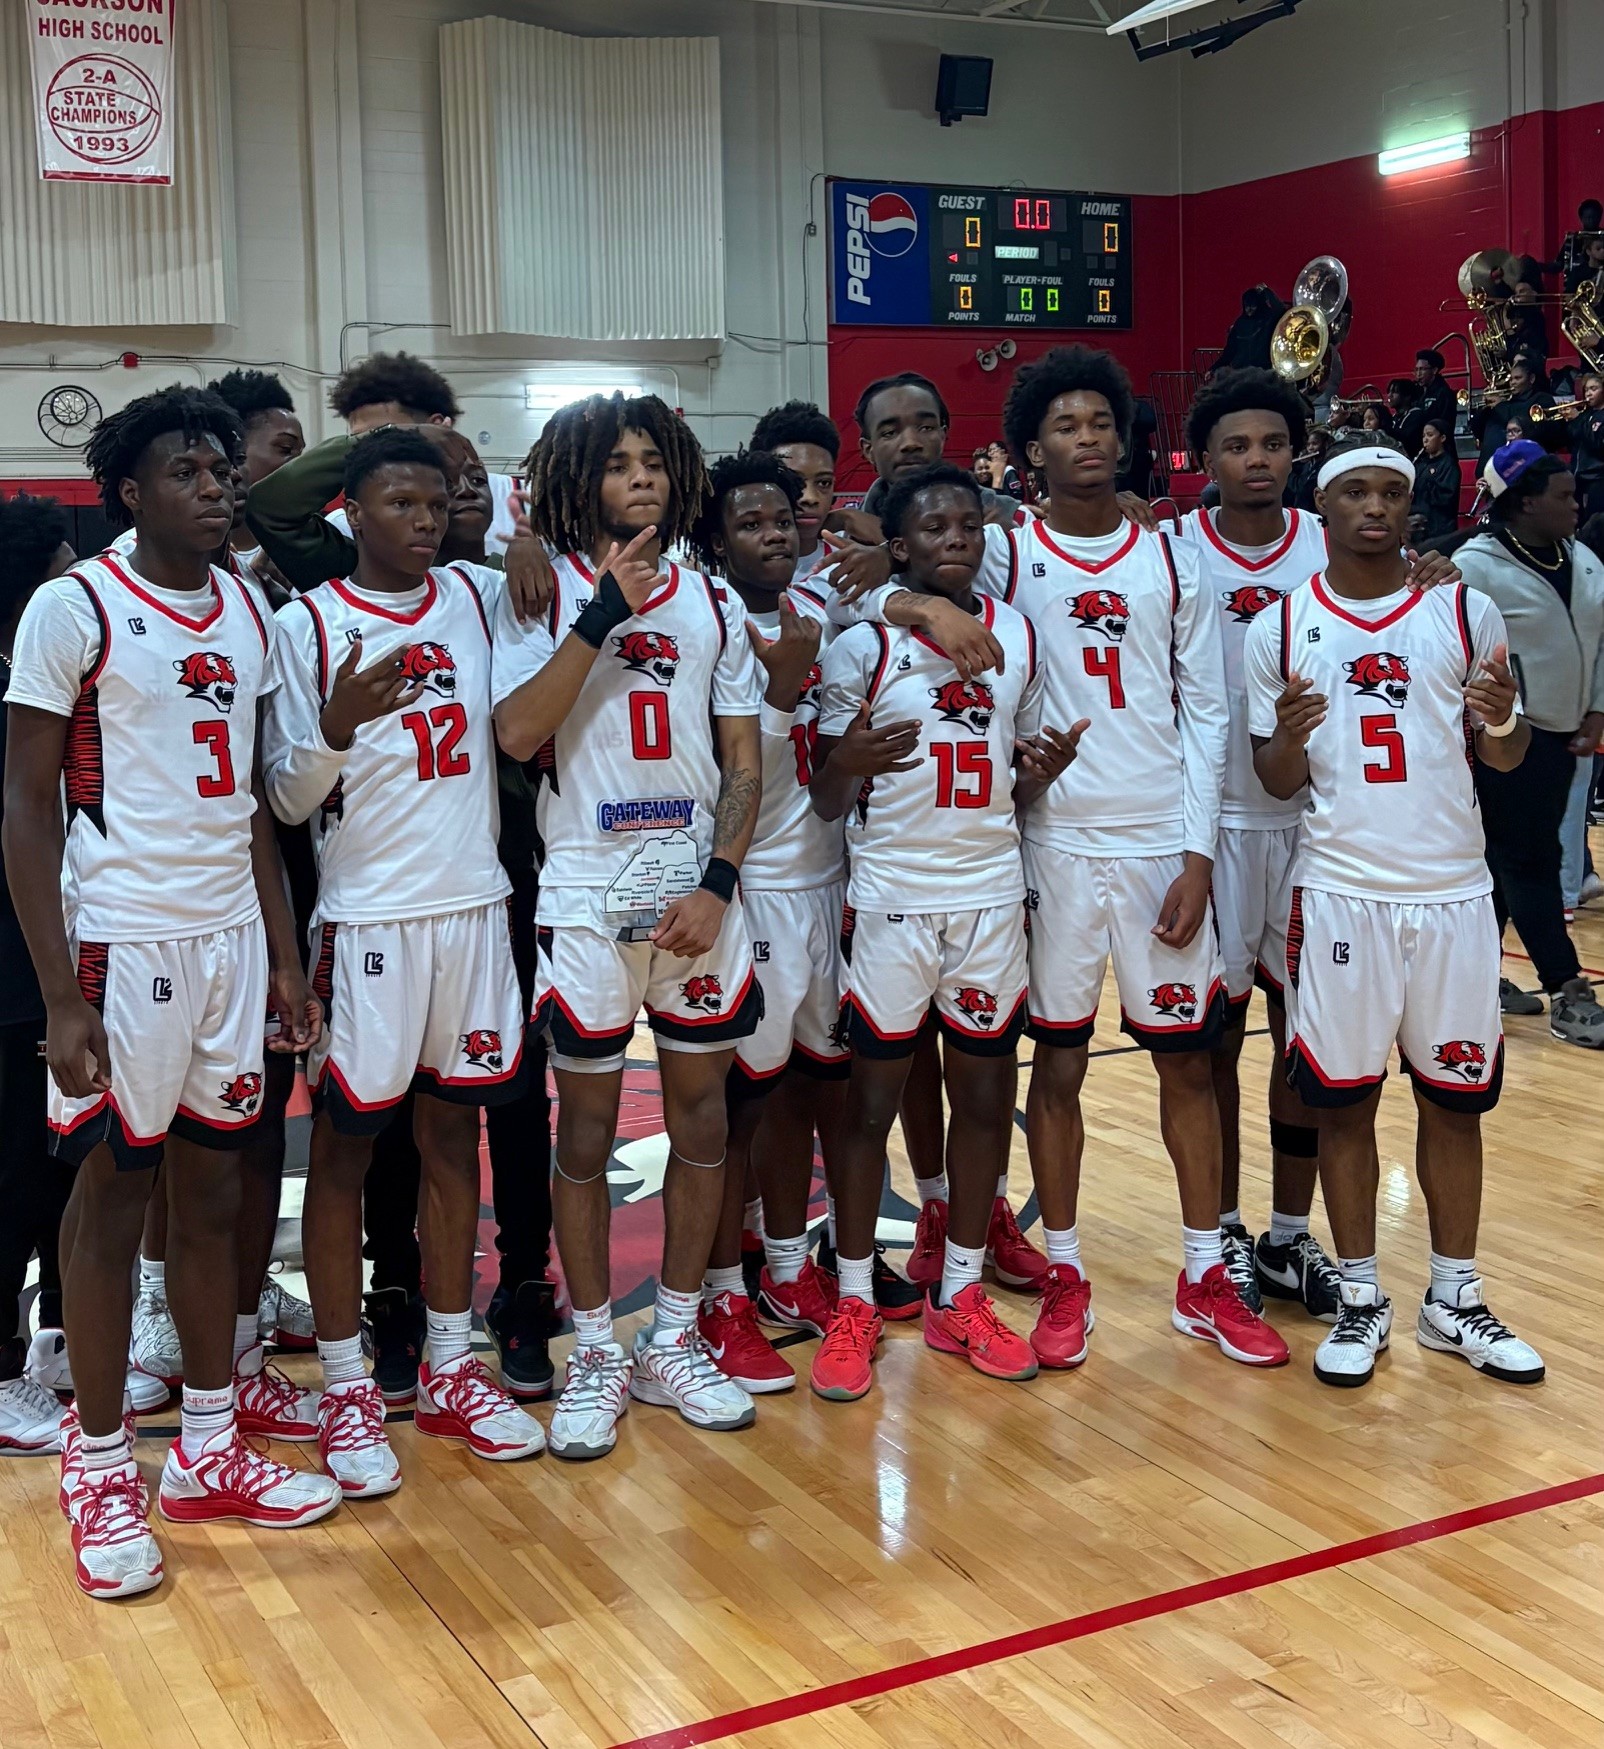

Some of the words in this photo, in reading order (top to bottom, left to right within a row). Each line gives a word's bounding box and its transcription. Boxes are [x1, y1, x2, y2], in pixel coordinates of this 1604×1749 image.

[36, 0, 163, 14] KSON
[38, 17, 84, 39] HIGH
[91, 21, 163, 45] SCHOOL
[82, 68, 117, 85] 2-A
[63, 90, 116, 107] STATE
[50, 106, 137, 125] CHAMPIONS
[73, 136, 130, 152] 1993
[938, 195, 986, 210] GUEST
[1081, 202, 1121, 216] HOME
[965, 217, 981, 248] 0
[1104, 222, 1119, 253] 0
[846, 192, 872, 306] PEPSI
[997, 247, 1037, 258] PERIOD
[949, 273, 977, 283] FOULS
[1088, 277, 1115, 287] FOULS
[960, 286, 972, 310] 0
[1020, 287, 1033, 311] 0
[1047, 288, 1059, 312] 0
[1098, 289, 1111, 313] 0
[948, 311, 980, 321] POINTS
[1005, 313, 1037, 323] MATCH
[1087, 314, 1117, 324] POINTS
[1082, 646, 1126, 709] 4
[628, 690, 673, 761] 0
[401, 702, 470, 782] 12
[788, 716, 820, 787] 1
[1360, 714, 1407, 784] 5
[192, 719, 236, 799] 3
[929, 740, 993, 809] 15
[600, 799, 695, 831] GATEWAY
[613, 818, 685, 830] CONFERENCE
